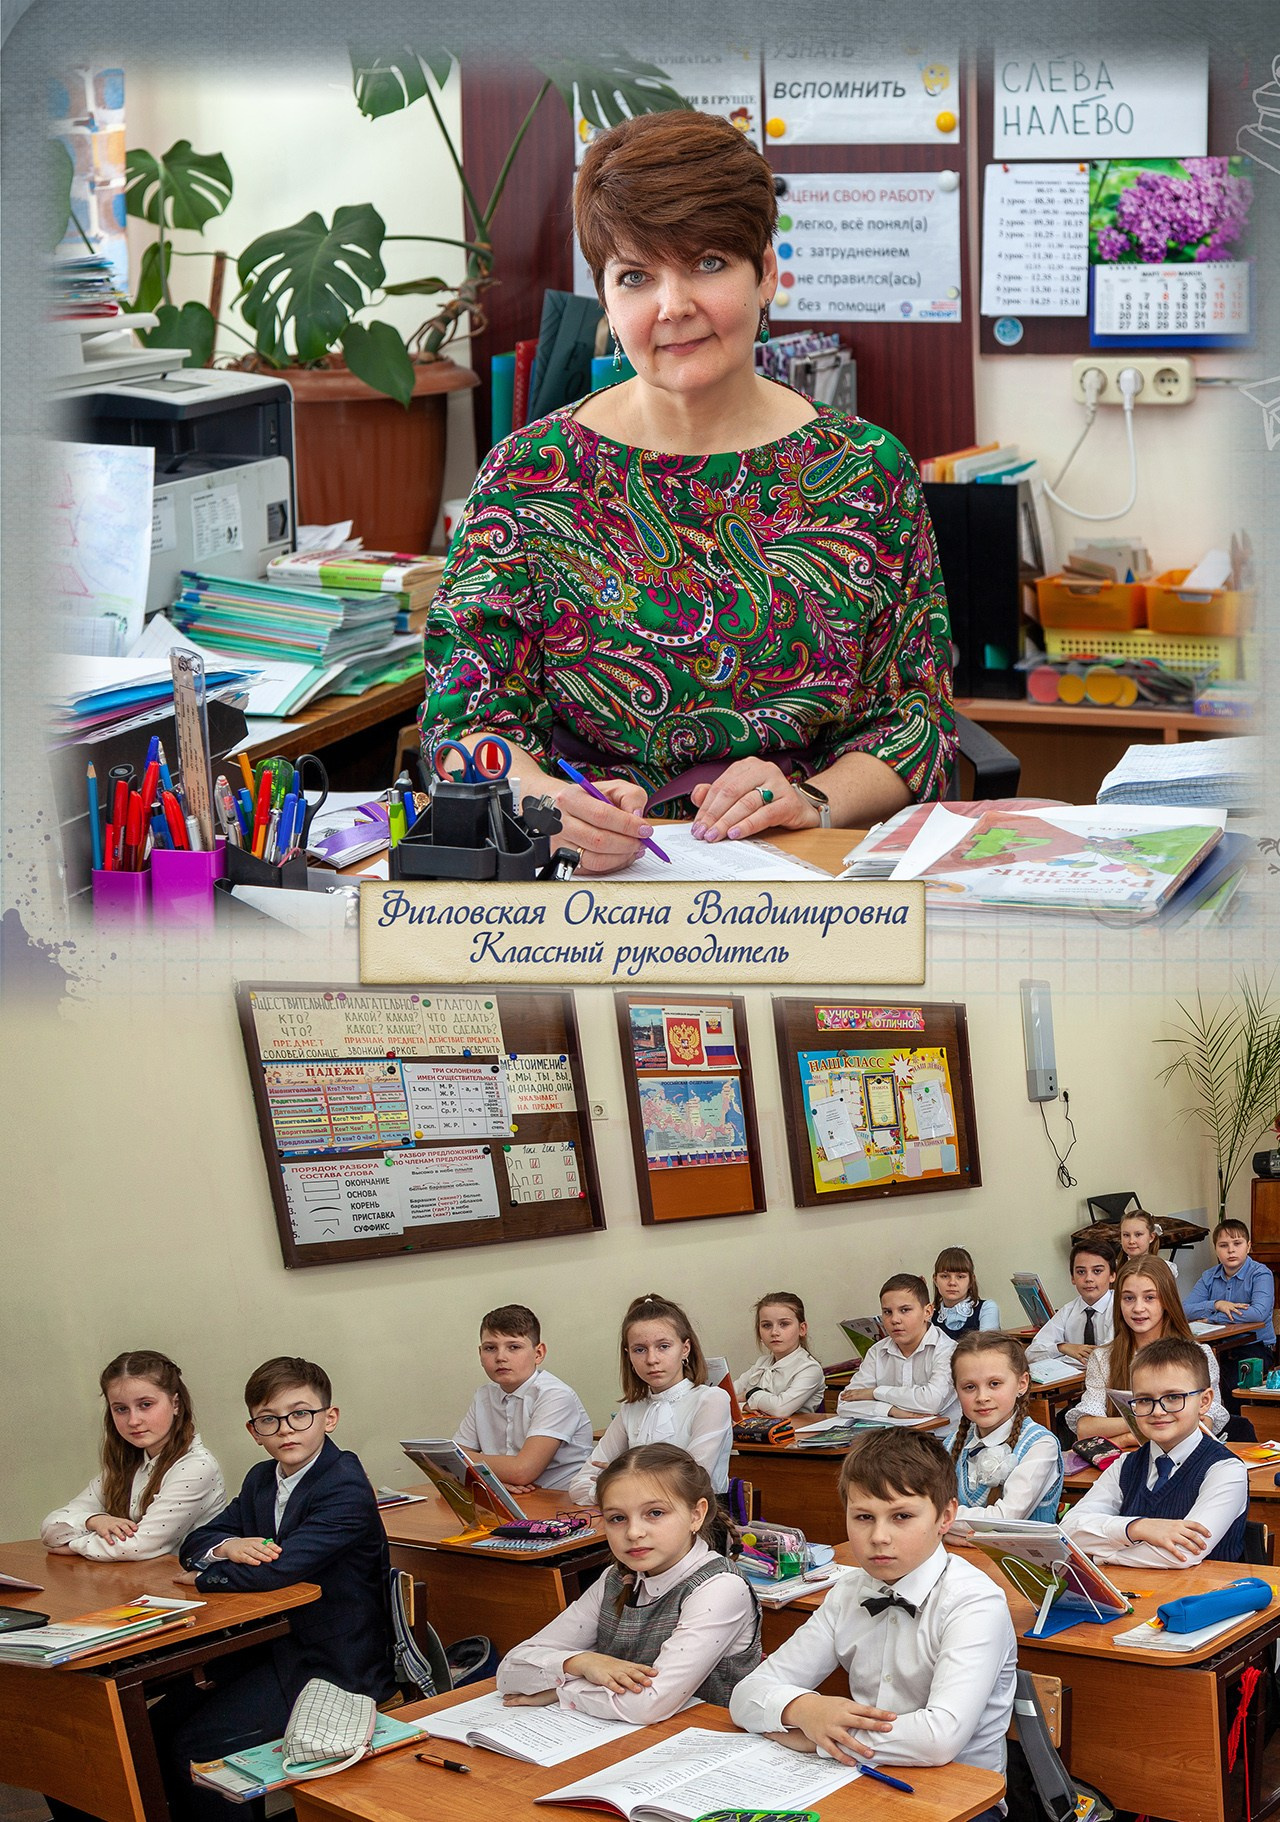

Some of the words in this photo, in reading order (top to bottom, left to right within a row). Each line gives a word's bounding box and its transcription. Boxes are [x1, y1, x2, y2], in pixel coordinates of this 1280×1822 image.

[773, 81, 906, 98] ВСПОМНИТЬ
[781, 189, 828, 203] ОЦЕНИ
[833, 189, 876, 202] СВОЮ
[880, 189, 935, 202] РАБОТУ
[795, 219, 837, 232] легко,
[841, 217, 863, 230] всё
[867, 216, 928, 232] понял(а)
[796, 247, 803, 257] с
[810, 247, 910, 260] затруднением
[797, 274, 814, 285] не
[817, 271, 921, 287] справился(ась)
[798, 298, 821, 311] без
[828, 301, 886, 313] помощи
[251, 997, 336, 1011] УЩЕСТВИТЕЛЬНОЕ
[436, 999, 482, 1011] ГЛАГОЛ
[279, 1012, 310, 1024] КТО?
[345, 1011, 381, 1022] КАКОЙ?
[386, 1012, 419, 1023] КАКАЯ?
[427, 1013, 446, 1022] ЧТО
[453, 1013, 495, 1023] ДЕЛАТЬ?
[829, 1009, 859, 1019] УЧИСЬ
[862, 1009, 873, 1019] НА
[281, 1025, 312, 1036] ЧТО?
[347, 1024, 383, 1034] КАКОЕ?
[386, 1024, 421, 1034] КАКИЕ?
[429, 1024, 447, 1034] ЧТО
[453, 1024, 497, 1035] СДЕЛАТЬ?
[273, 1039, 324, 1047] ПРЕДМЕТ
[348, 1045, 384, 1056] ЗВОНКИЙ
[501, 1059, 566, 1071] МЕСТОИМЕНИЕ
[808, 1056, 841, 1072] НАШ
[842, 1056, 885, 1069] КЛАСС
[306, 1067, 365, 1077] ПАДЕЖИ
[271, 1096, 318, 1105] Родительный
[273, 1107, 313, 1116] Дательный
[275, 1117, 322, 1126] Винительный
[277, 1127, 328, 1136] Творительный
[278, 1138, 325, 1147] Предложный
[428, 1148, 479, 1157] ПРЕДЛОЖЕНИЯ
[405, 1157, 434, 1165] ЧЛЕНАМ
[435, 1154, 486, 1163] ПРЕДЛОЖЕНИЯ
[291, 1165, 337, 1173] ПОРЯДОК
[345, 1177, 390, 1187] ОКОНЧАНИЕ
[347, 1190, 377, 1199] ОСНОВА
[351, 1201, 380, 1210] КОРЕНЬ
[353, 1211, 395, 1221] ПРИСТАВКА
[354, 1223, 390, 1233] СУФФИКС
